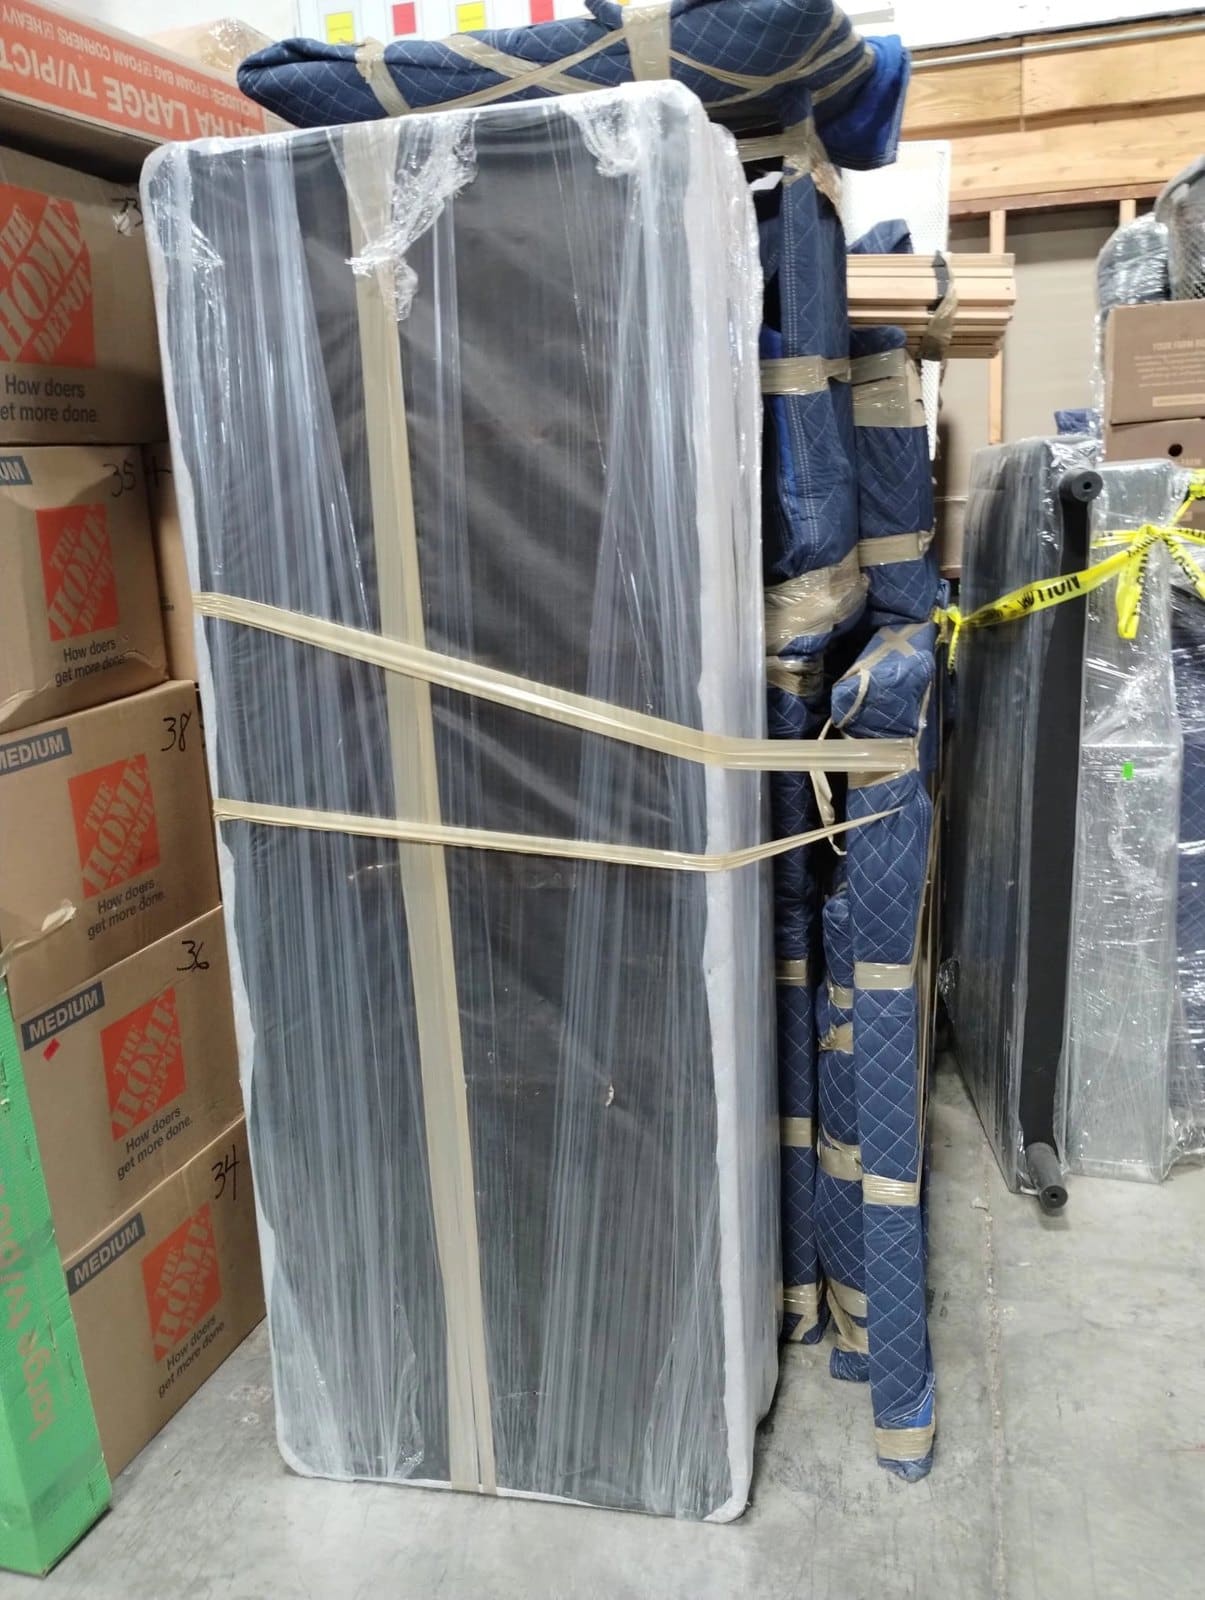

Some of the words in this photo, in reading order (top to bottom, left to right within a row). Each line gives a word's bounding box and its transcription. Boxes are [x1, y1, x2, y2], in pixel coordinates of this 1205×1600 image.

[2, 4, 43, 35] HEAVY
[57, 27, 111, 61] CORNERS
[103, 76, 190, 136] LARGE
[34, 259, 92, 361] DEPOT
[5, 374, 41, 396] How
[44, 376, 86, 399] doers
[20, 404, 58, 423] more
[103, 461, 136, 498] 35
[48, 505, 108, 637] HOME
[50, 527, 77, 570] THE
[55, 667, 73, 688] get
[75, 662, 101, 679] more
[63, 647, 87, 662] How
[90, 640, 117, 655] doers
[161, 712, 192, 751] 38
[81, 758, 149, 891] HOME
[83, 780, 112, 832] THE
[110, 800, 154, 880] DEPOT
[88, 918, 106, 941] get
[108, 905, 137, 928] more
[97, 893, 123, 915] How
[125, 880, 155, 901] doers
[177, 940, 210, 972] 36
[29, 989, 99, 1044] MEDIUM
[111, 996, 177, 1130] HOME
[113, 1023, 141, 1073] THE
[143, 1035, 181, 1111] DEPOT
[126, 1129, 150, 1154] How
[152, 1107, 181, 1135] doers
[117, 1156, 136, 1181] get
[138, 1137, 164, 1163] more
[211, 1144, 240, 1201] 34
[73, 1220, 140, 1287] MEDIUM
[154, 1246, 179, 1300] THE
[153, 1215, 212, 1346] HOME
[166, 1343, 189, 1372] How
[191, 1314, 216, 1347] doers
[159, 1372, 175, 1399] get
[177, 1347, 201, 1377] more
